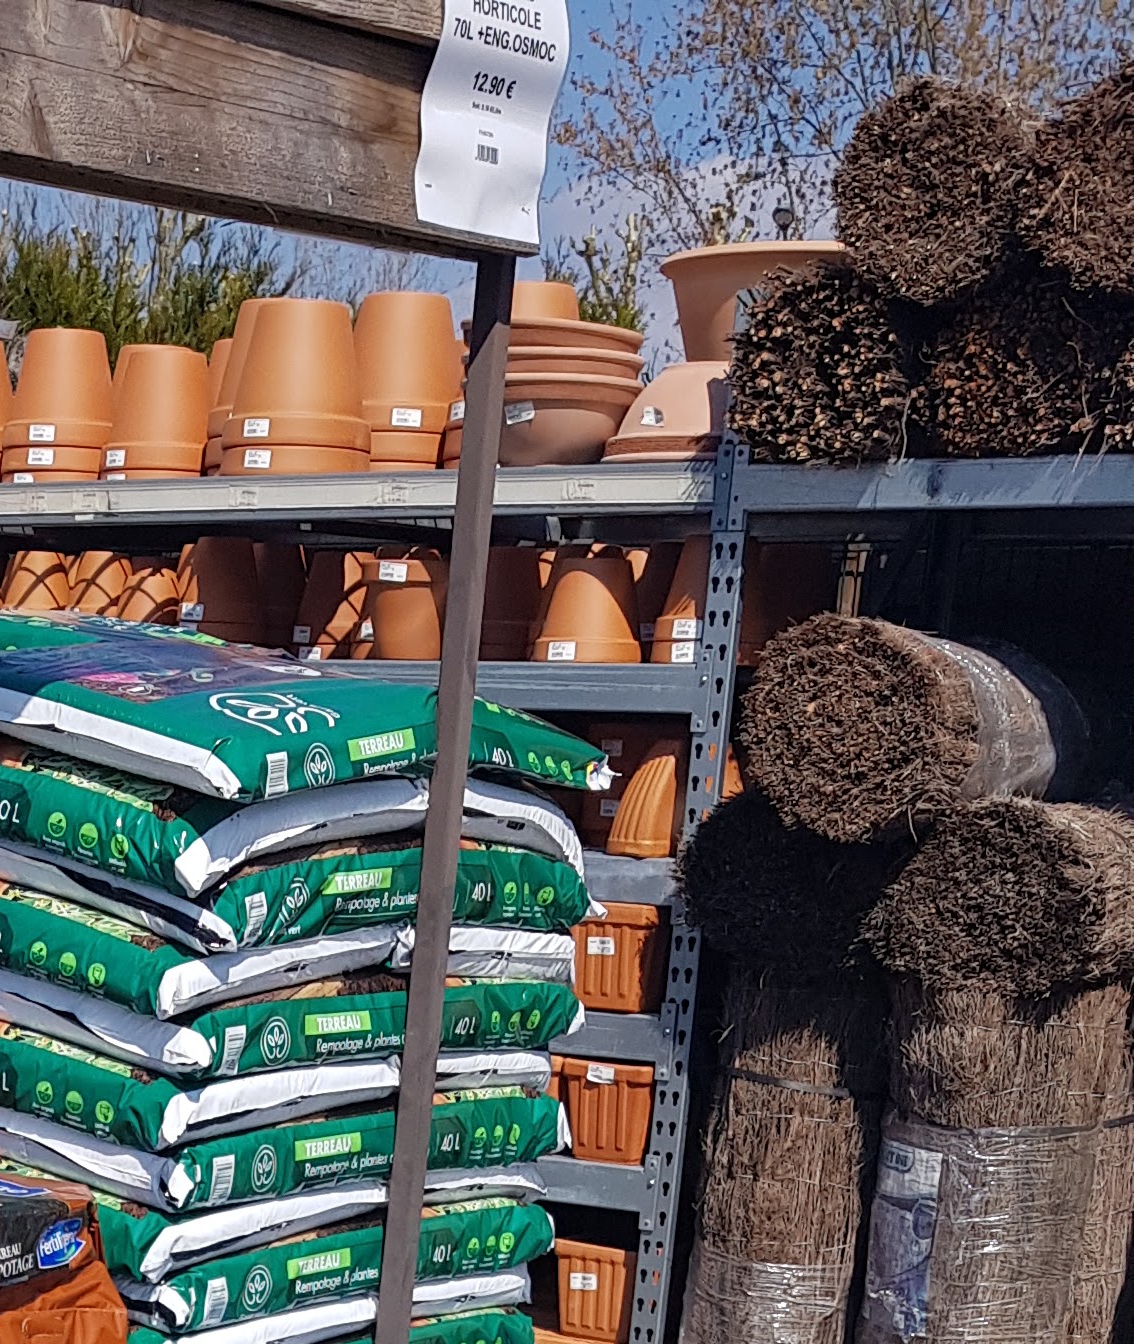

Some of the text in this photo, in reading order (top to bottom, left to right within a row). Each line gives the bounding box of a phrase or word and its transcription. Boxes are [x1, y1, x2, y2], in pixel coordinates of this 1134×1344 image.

[473, 0, 541, 30] HORTICOLE
[454, 18, 556, 62] 70L +ENG.OSMOC
[473, 71, 516, 99] 12.90 €
[358, 733, 404, 756] TERREAU
[492, 747, 506, 766] 40
[12, 803, 20, 824] L
[334, 871, 383, 893] TERREAU
[471, 884, 486, 901] 40
[316, 1015, 361, 1031] TERREAU
[455, 1016, 469, 1035] 40
[316, 1032, 400, 1053] Rempotage plantes
[305, 1136, 351, 1157] TERREAU
[441, 1133, 454, 1151] 40
[360, 1154, 388, 1173] plantes
[298, 1253, 340, 1274] TERREAU
[433, 1245, 446, 1263] 40
[295, 1265, 379, 1295] Rempotage plantes
